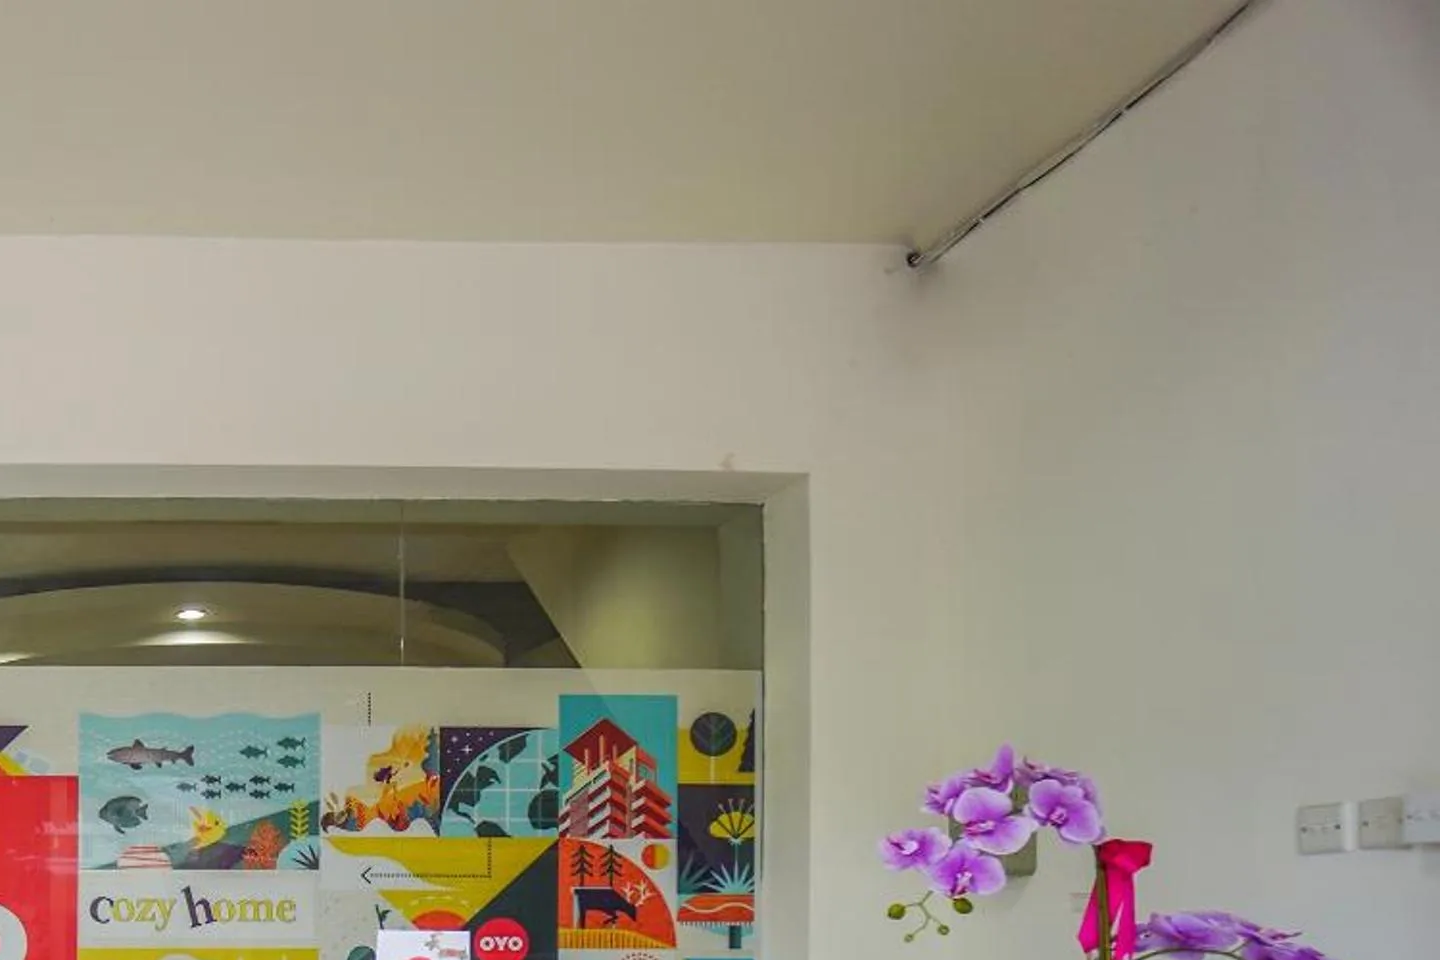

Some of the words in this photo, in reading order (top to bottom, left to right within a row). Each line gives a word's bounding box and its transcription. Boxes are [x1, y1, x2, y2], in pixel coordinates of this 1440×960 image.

[89, 895, 177, 932] cozy
[181, 885, 297, 929] home
[479, 935, 524, 952] OYO
